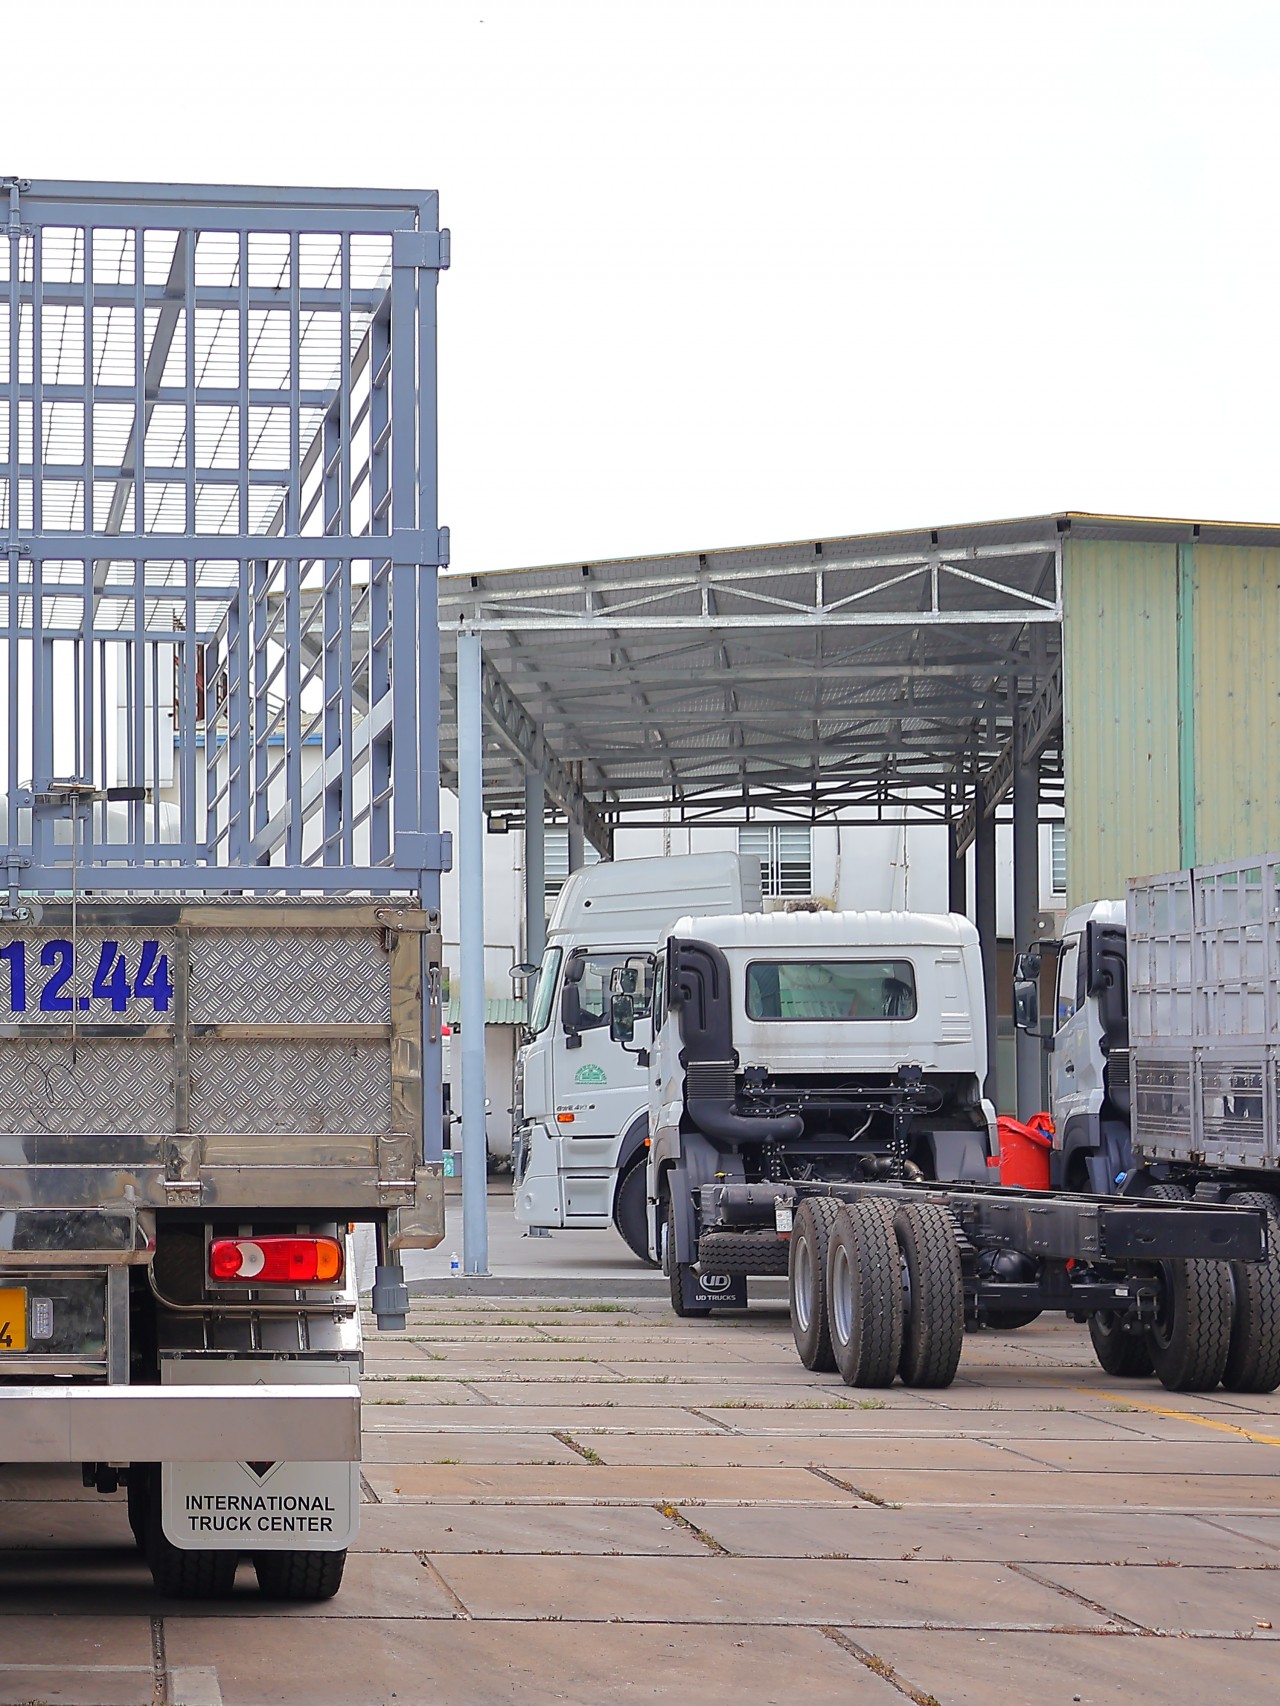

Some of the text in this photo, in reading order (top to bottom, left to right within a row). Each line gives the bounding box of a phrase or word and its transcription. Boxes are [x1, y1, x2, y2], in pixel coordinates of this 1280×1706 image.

[703, 1275, 728, 1286] UD
[185, 1495, 335, 1512] INTERNATIONAL
[188, 1515, 333, 1532] TRUCK CENTER
